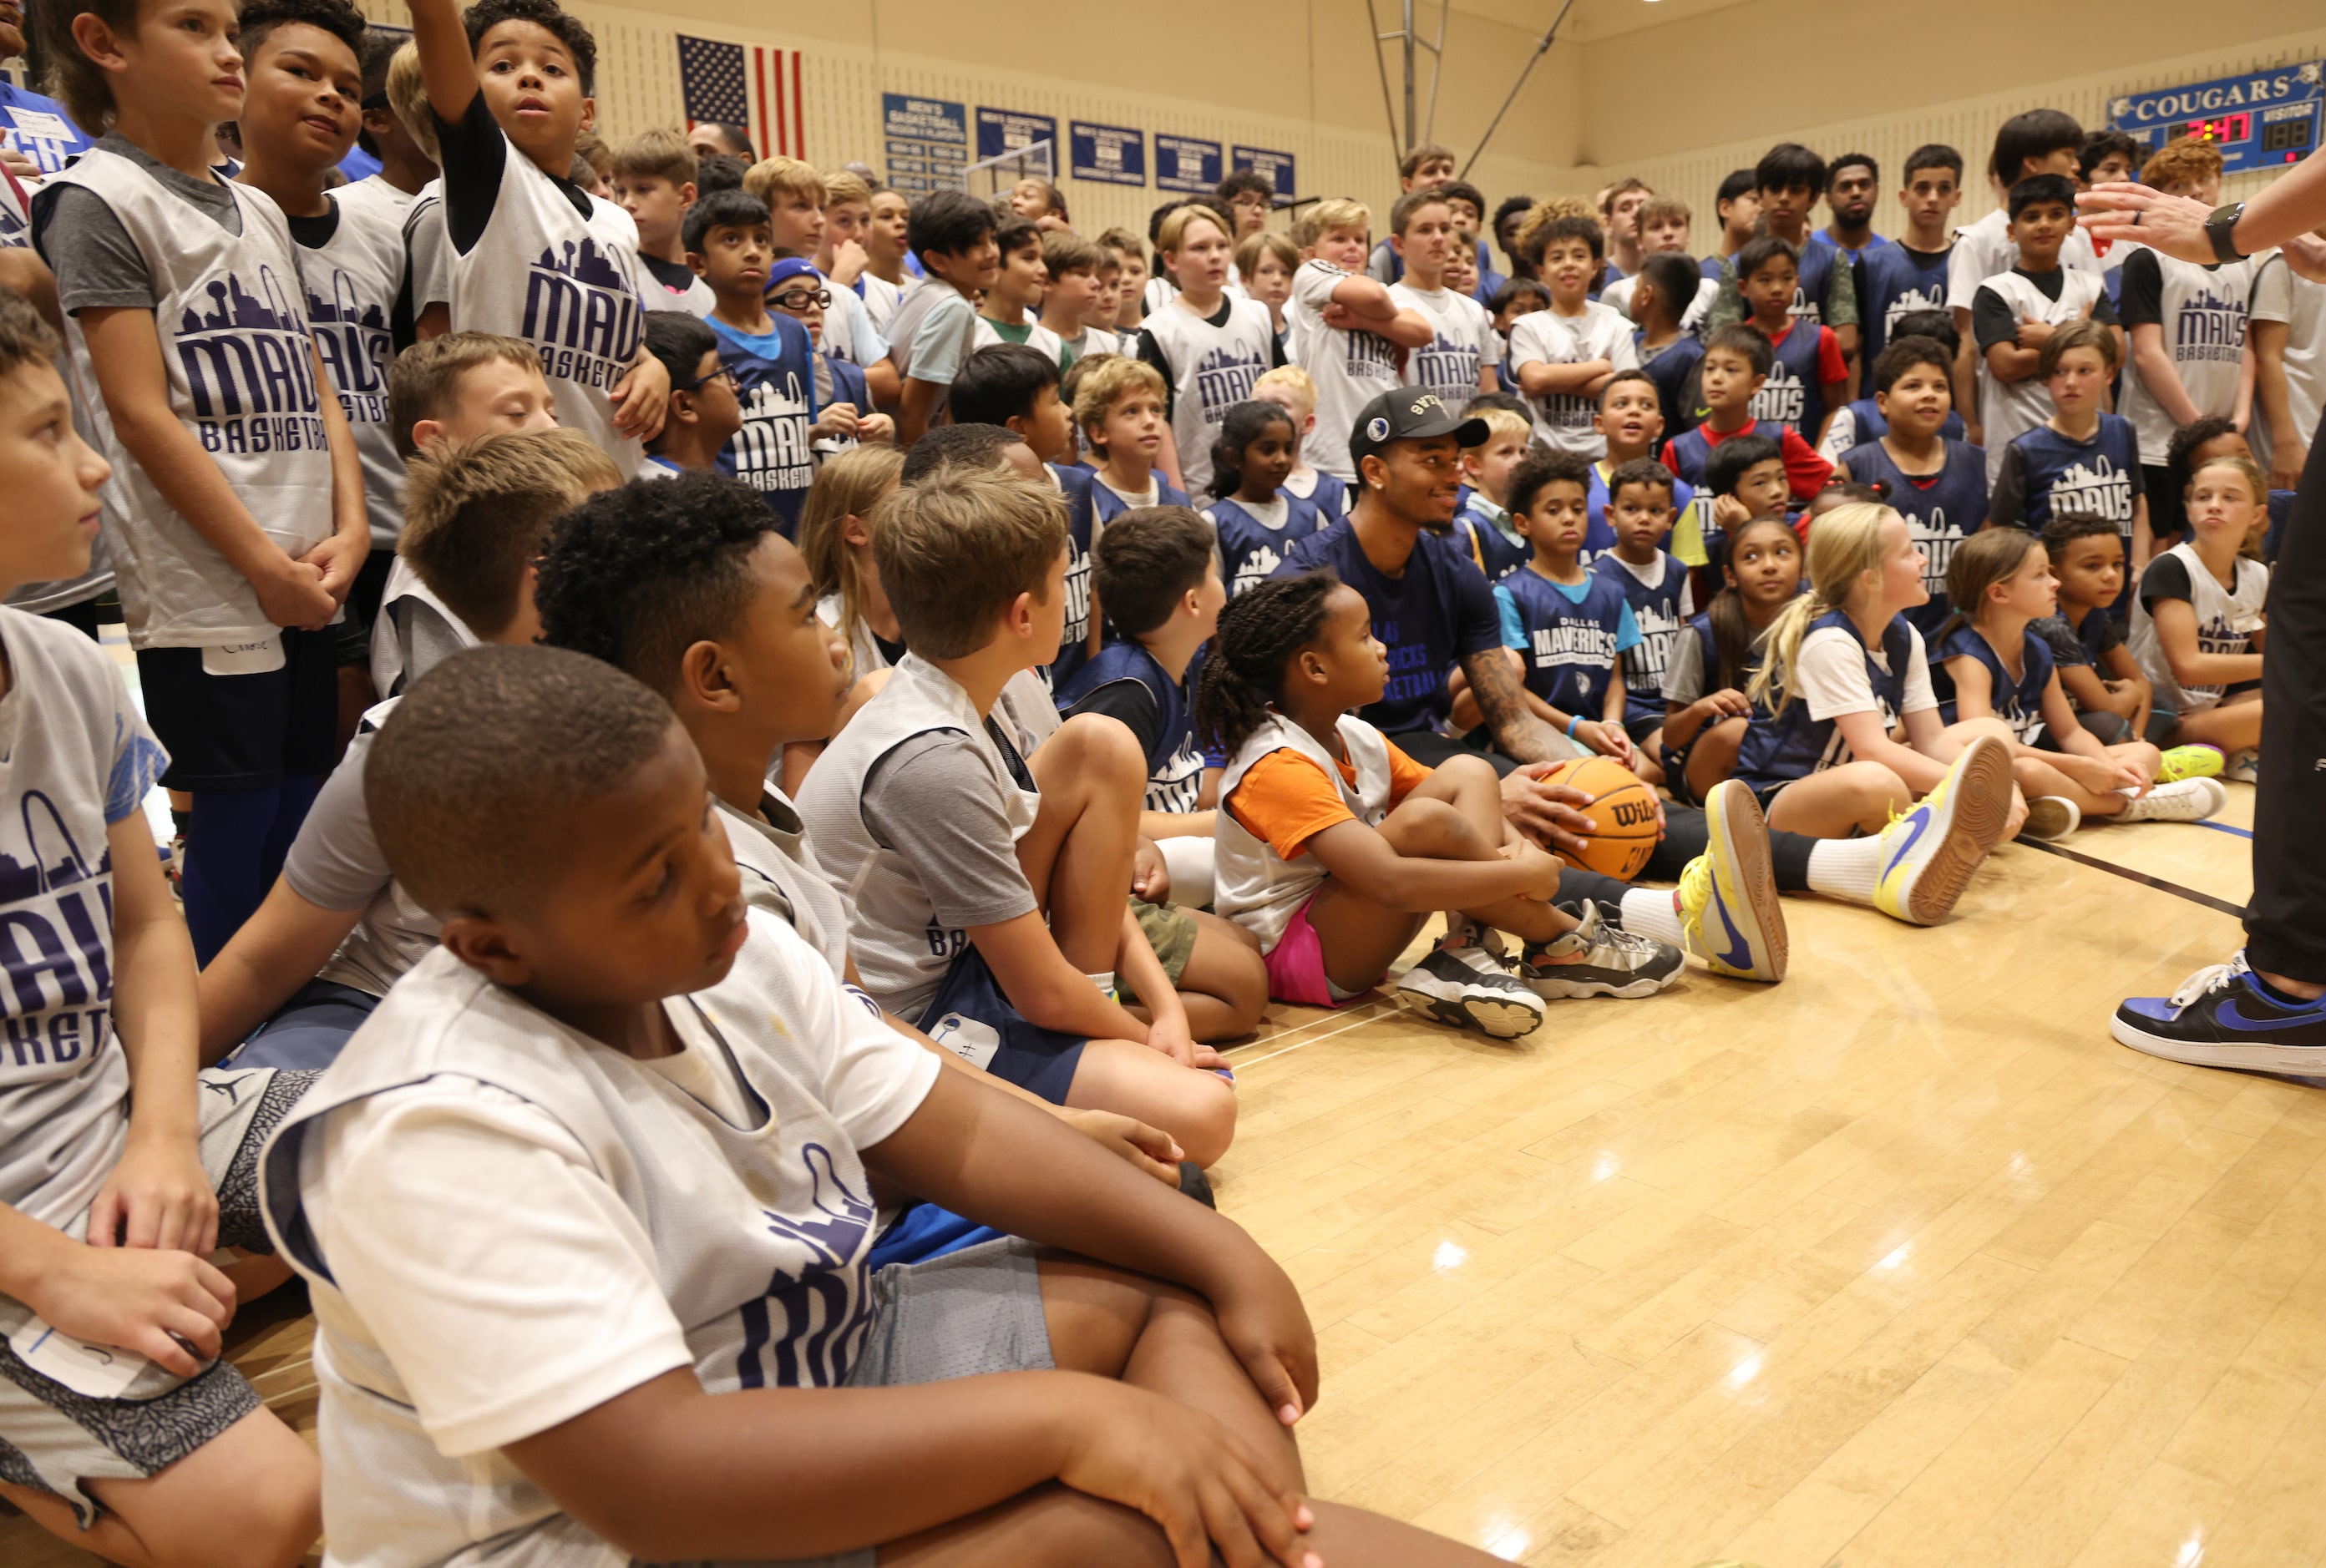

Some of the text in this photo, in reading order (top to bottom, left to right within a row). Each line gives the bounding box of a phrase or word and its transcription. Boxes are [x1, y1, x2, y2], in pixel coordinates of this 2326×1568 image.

[2136, 75, 2291, 121] COUGARS
[522, 271, 644, 363] MAV
[176, 334, 318, 417] MAV
[1748, 388, 1804, 421] AVS
[1533, 626, 1617, 659] MAVERICS
